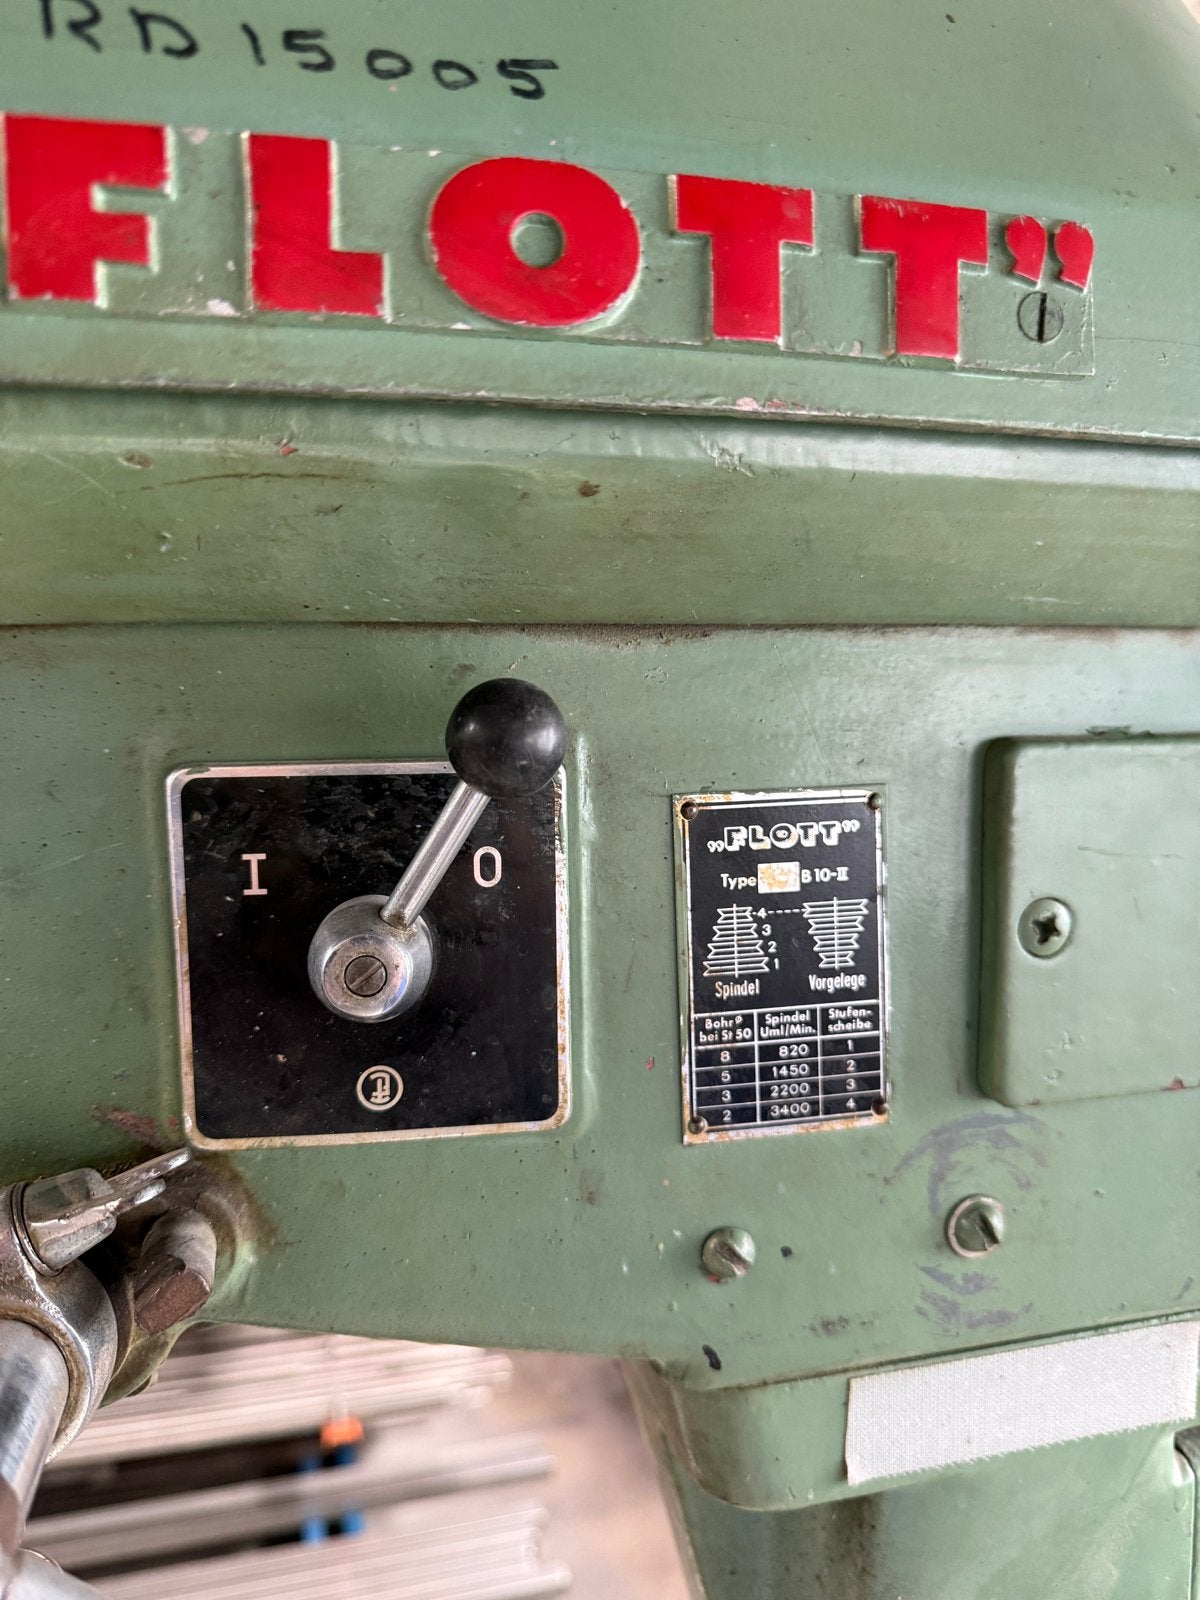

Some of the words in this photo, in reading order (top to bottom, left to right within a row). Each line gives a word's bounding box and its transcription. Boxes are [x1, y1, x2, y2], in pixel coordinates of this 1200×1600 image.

[721, 873, 757, 890] Type
[802, 870, 811, 883] B
[757, 908, 767, 919] 4
[762, 925, 772, 936] 3
[768, 941, 777, 952] 2
[774, 958, 780, 970] 1
[715, 979, 760, 999] Spindel
[809, 973, 867, 993] Vorgelege
[765, 1010, 810, 1026] Spindel
[829, 1007, 873, 1019] Stufen-
[705, 1018, 733, 1030] Bohr
[828, 1020, 871, 1032] scheibe
[700, 1032, 719, 1042] bei
[722, 1032, 734, 1040] St
[736, 1028, 752, 1039] 50
[779, 1044, 809, 1057] 820
[847, 1040, 854, 1051] 1
[720, 1051, 731, 1062] 8
[772, 1064, 809, 1078] 1450
[846, 1059, 856, 1071] 2
[721, 1071, 731, 1082] 5
[770, 1082, 810, 1097] 2200
[846, 1079, 856, 1090] 3
[722, 1090, 731, 1101] 3
[770, 1102, 810, 1116] 3400
[846, 1098, 856, 1110] 4
[722, 1110, 732, 1121] 2
